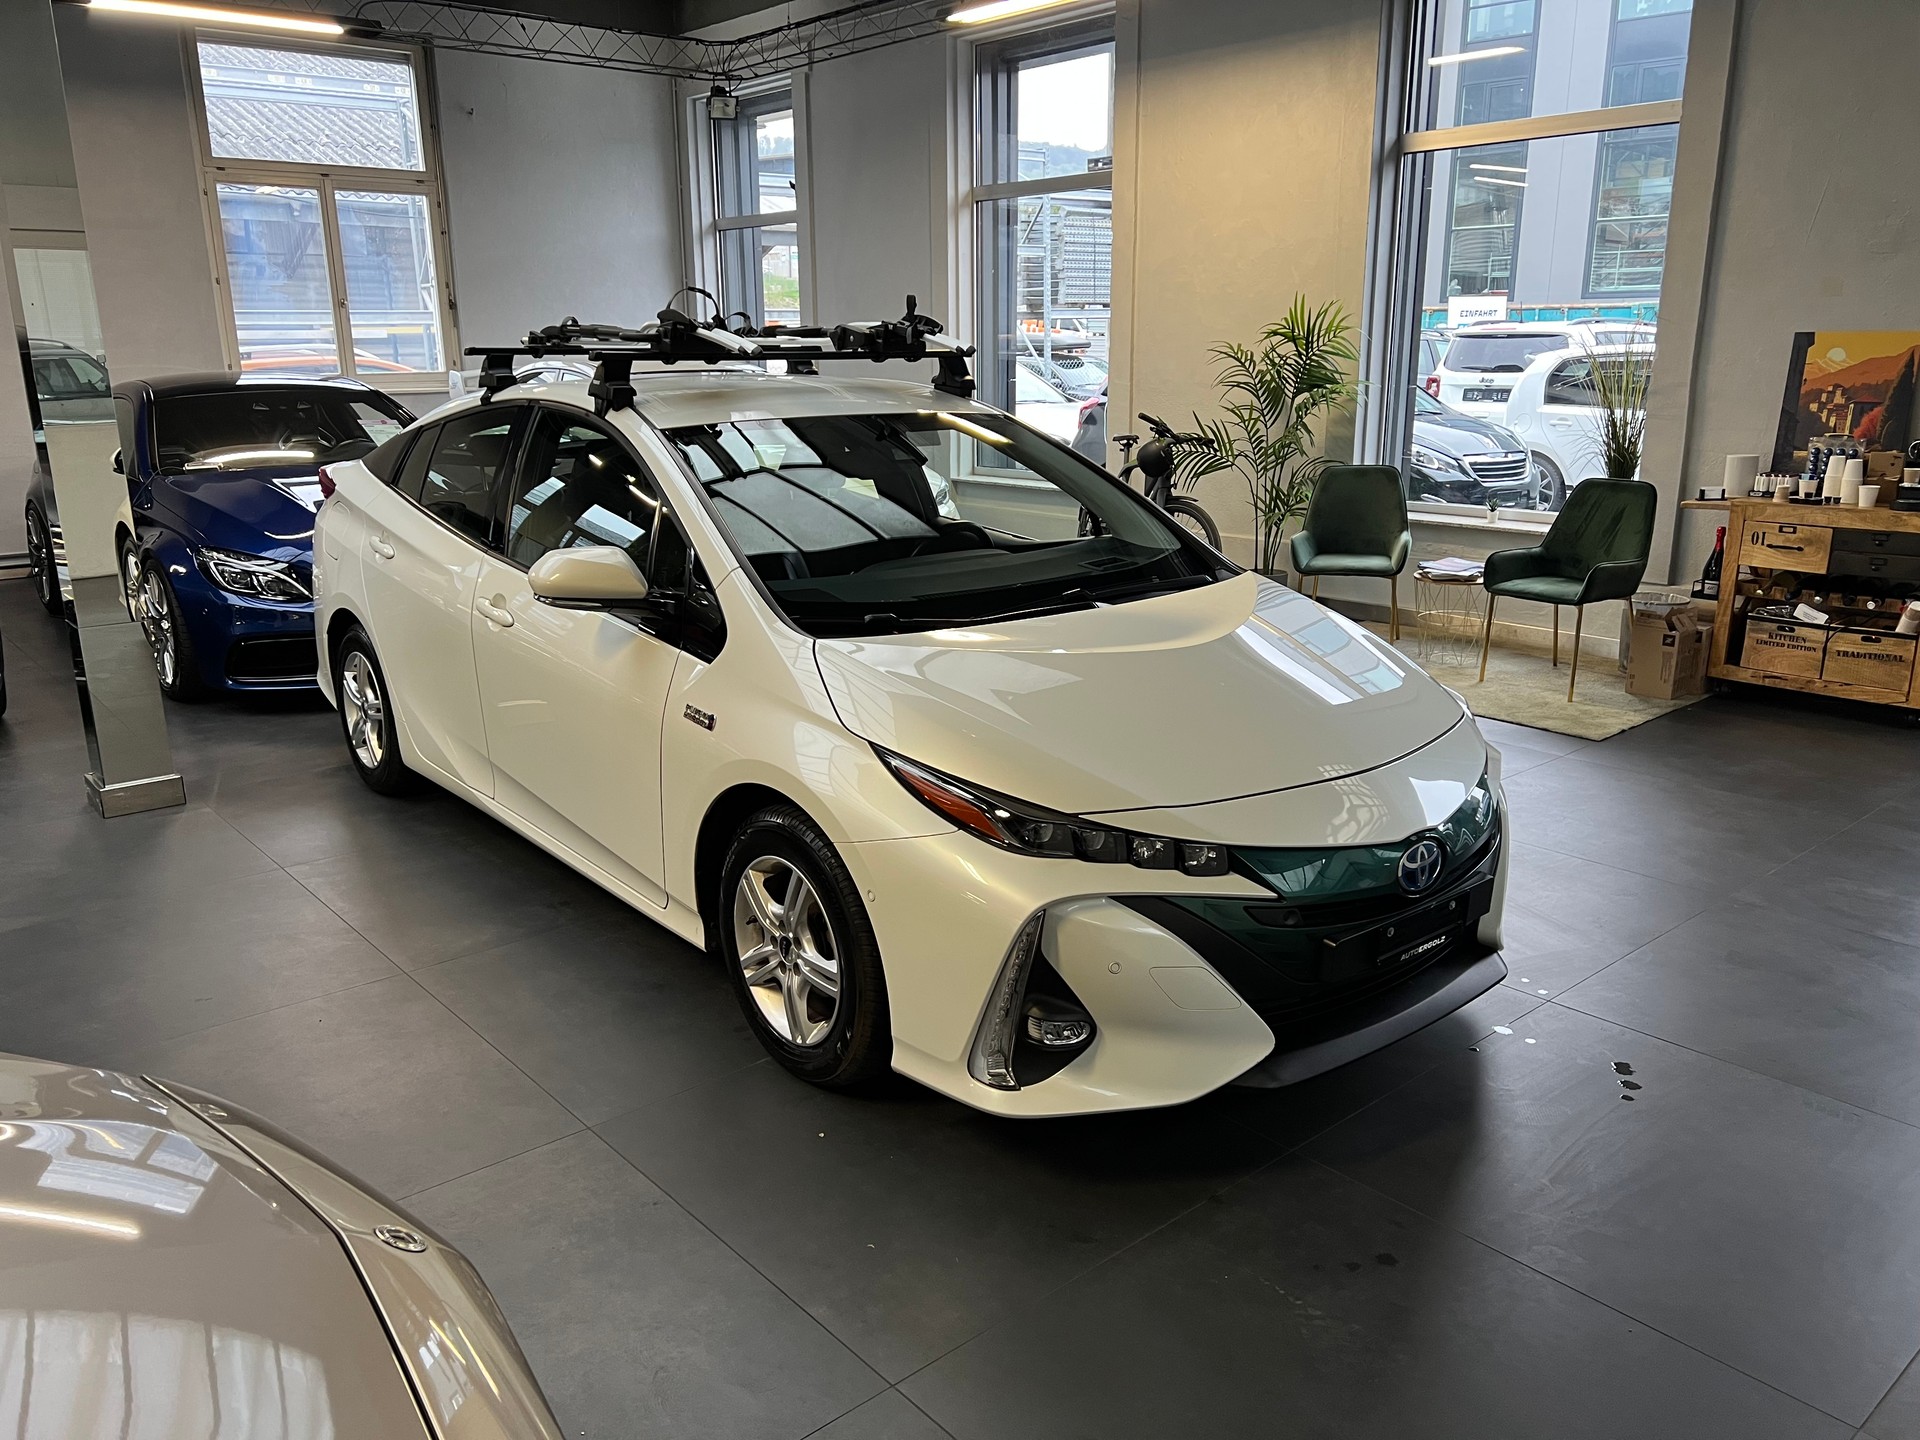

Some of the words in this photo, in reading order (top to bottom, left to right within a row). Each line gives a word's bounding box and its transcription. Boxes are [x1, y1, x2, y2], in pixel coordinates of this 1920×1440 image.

[1459, 309, 1498, 318] EINFAHRT
[1768, 632, 1807, 644] KITCHEN
[1756, 639, 1786, 648] LIMITED
[1786, 643, 1817, 652] EDITION
[1835, 649, 1905, 662] TRADITIONAL
[1400, 935, 1446, 961] AUTOERGOLZ
